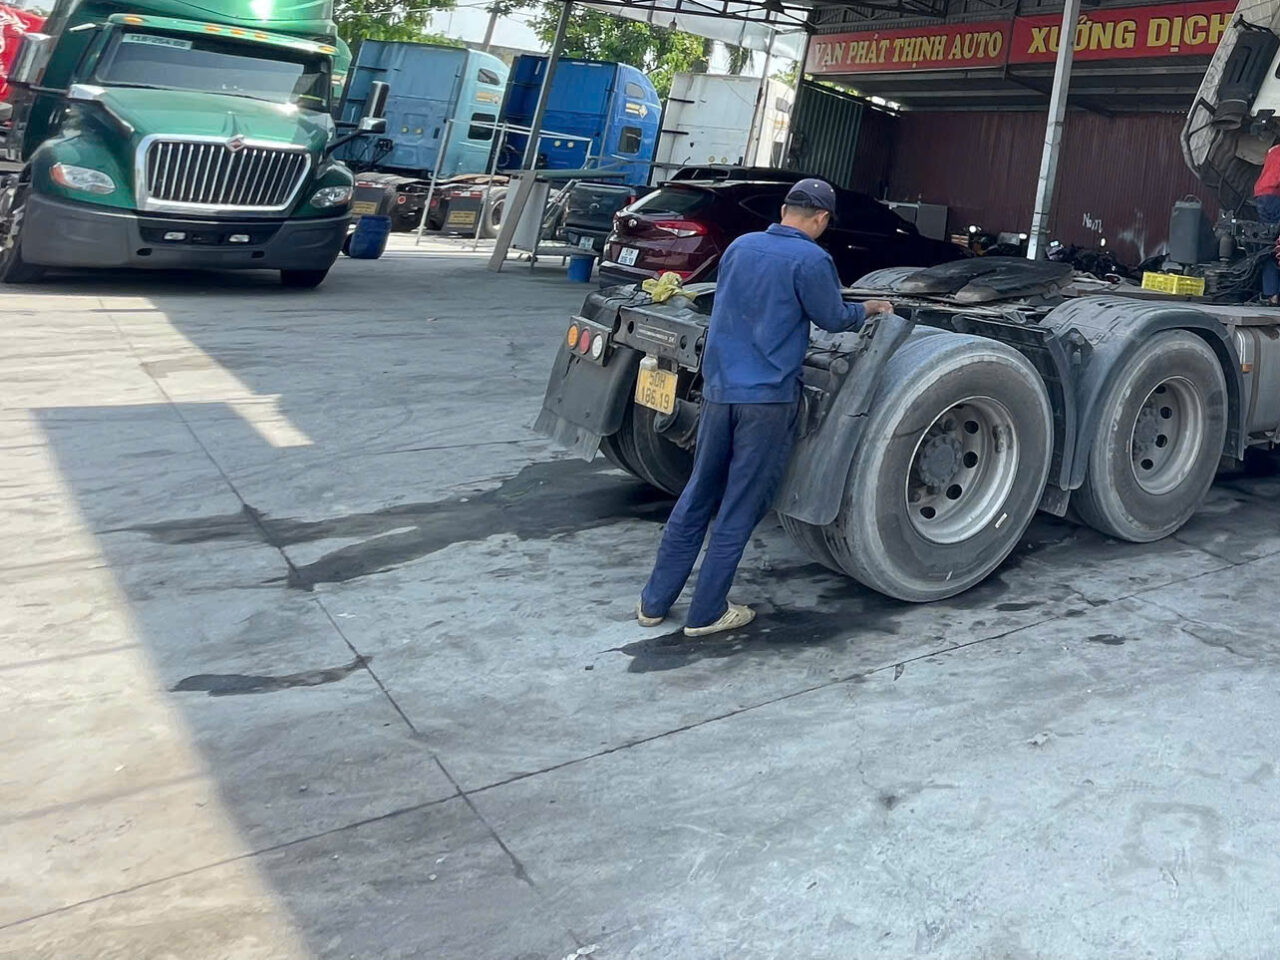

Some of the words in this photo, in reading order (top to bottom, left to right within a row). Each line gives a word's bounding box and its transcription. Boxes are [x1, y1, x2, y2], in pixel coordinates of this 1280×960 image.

[815, 42, 846, 71] VẠN
[846, 33, 890, 64] PHÁT
[892, 35, 947, 68] THỊNH
[948, 31, 1003, 59] AUTO
